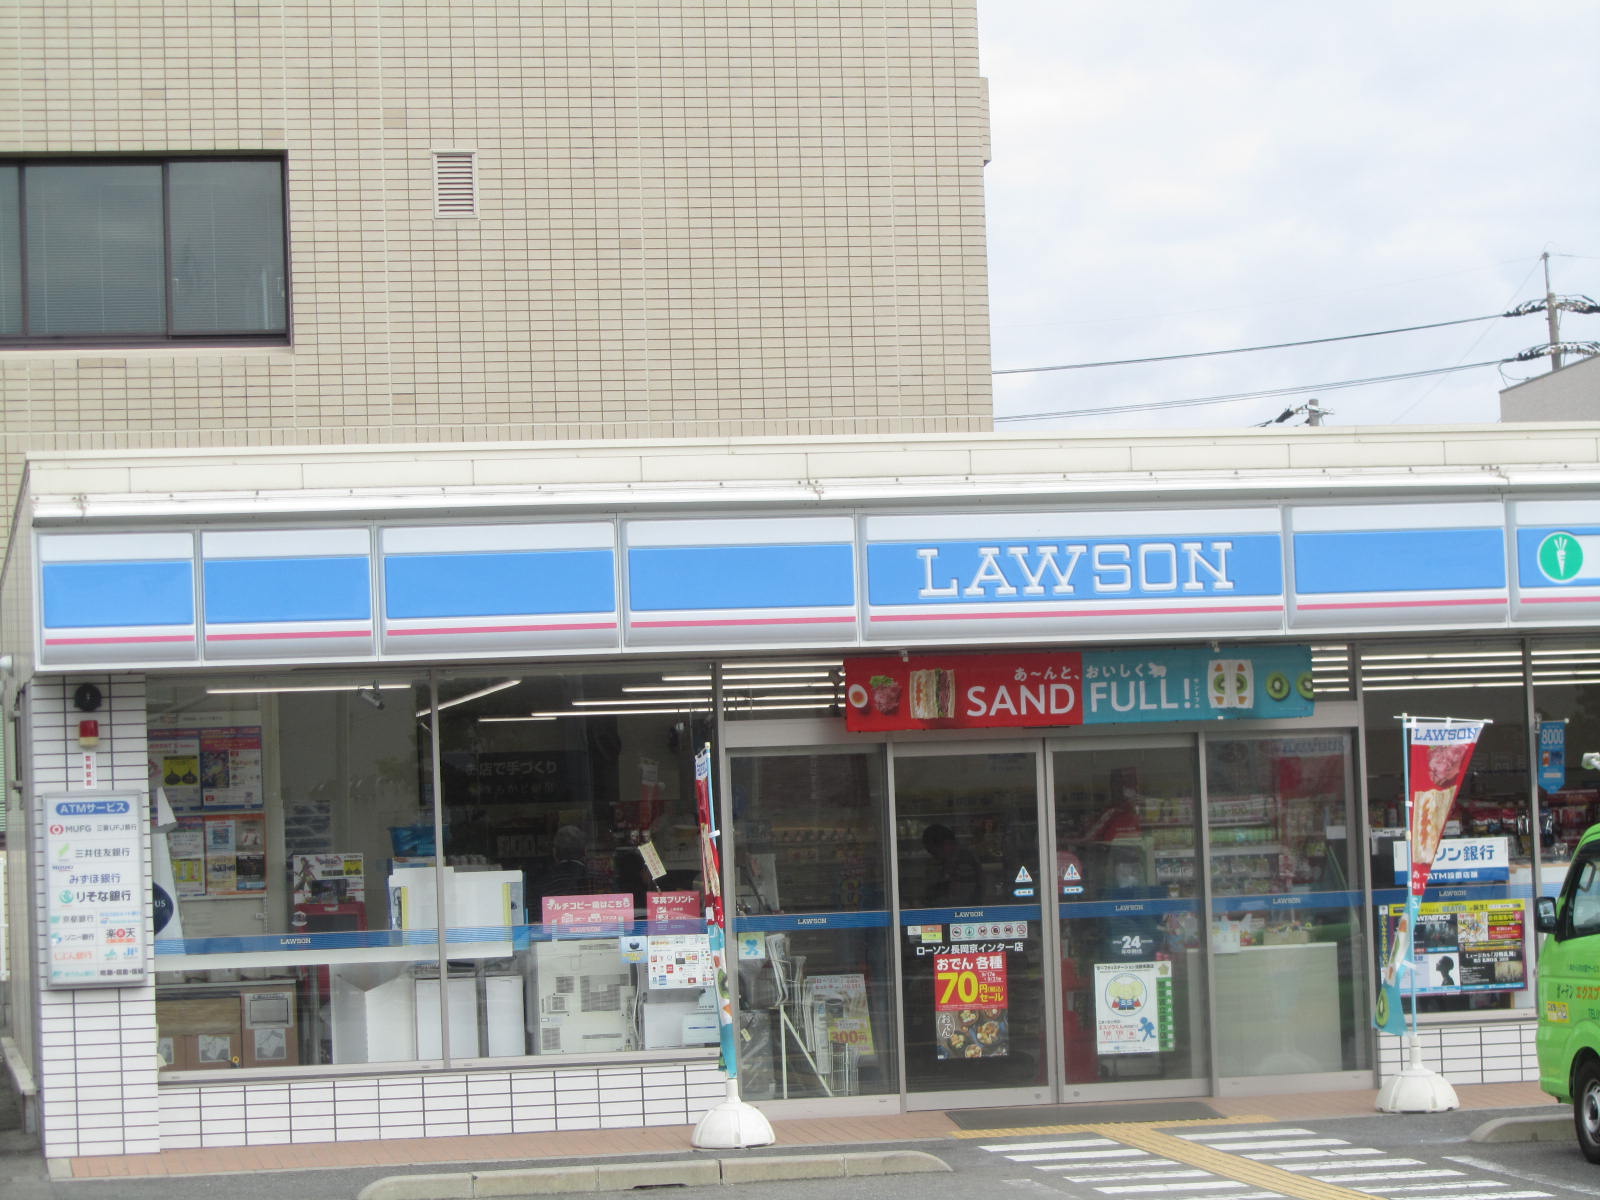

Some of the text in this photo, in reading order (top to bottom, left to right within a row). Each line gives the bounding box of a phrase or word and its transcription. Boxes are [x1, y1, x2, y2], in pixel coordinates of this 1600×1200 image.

[916, 541, 1235, 598] LAWSON
[1086, 664, 1144, 679] おいしく
[966, 678, 1191, 717] SAND FULL!
[1414, 727, 1479, 741] LAWSON
[60, 802, 126, 814] ATMサービス
[65, 825, 92, 833] MUFG
[75, 847, 131, 859] 三井住友銀行
[69, 872, 121, 884] みずほ銀行
[76, 890, 132, 903] りそな銀行
[652, 896, 695, 905] 写真プリント
[154, 900, 167, 908] US
[797, 917, 827, 925] LAWSON
[280, 937, 311, 945] LAWSON
[1121, 935, 1142, 949] 24
[937, 954, 1003, 971] おでん 各種
[937, 970, 979, 1004] 70
[980, 992, 1004, 1002] セール
[941, 1012, 952, 1039] おでん
